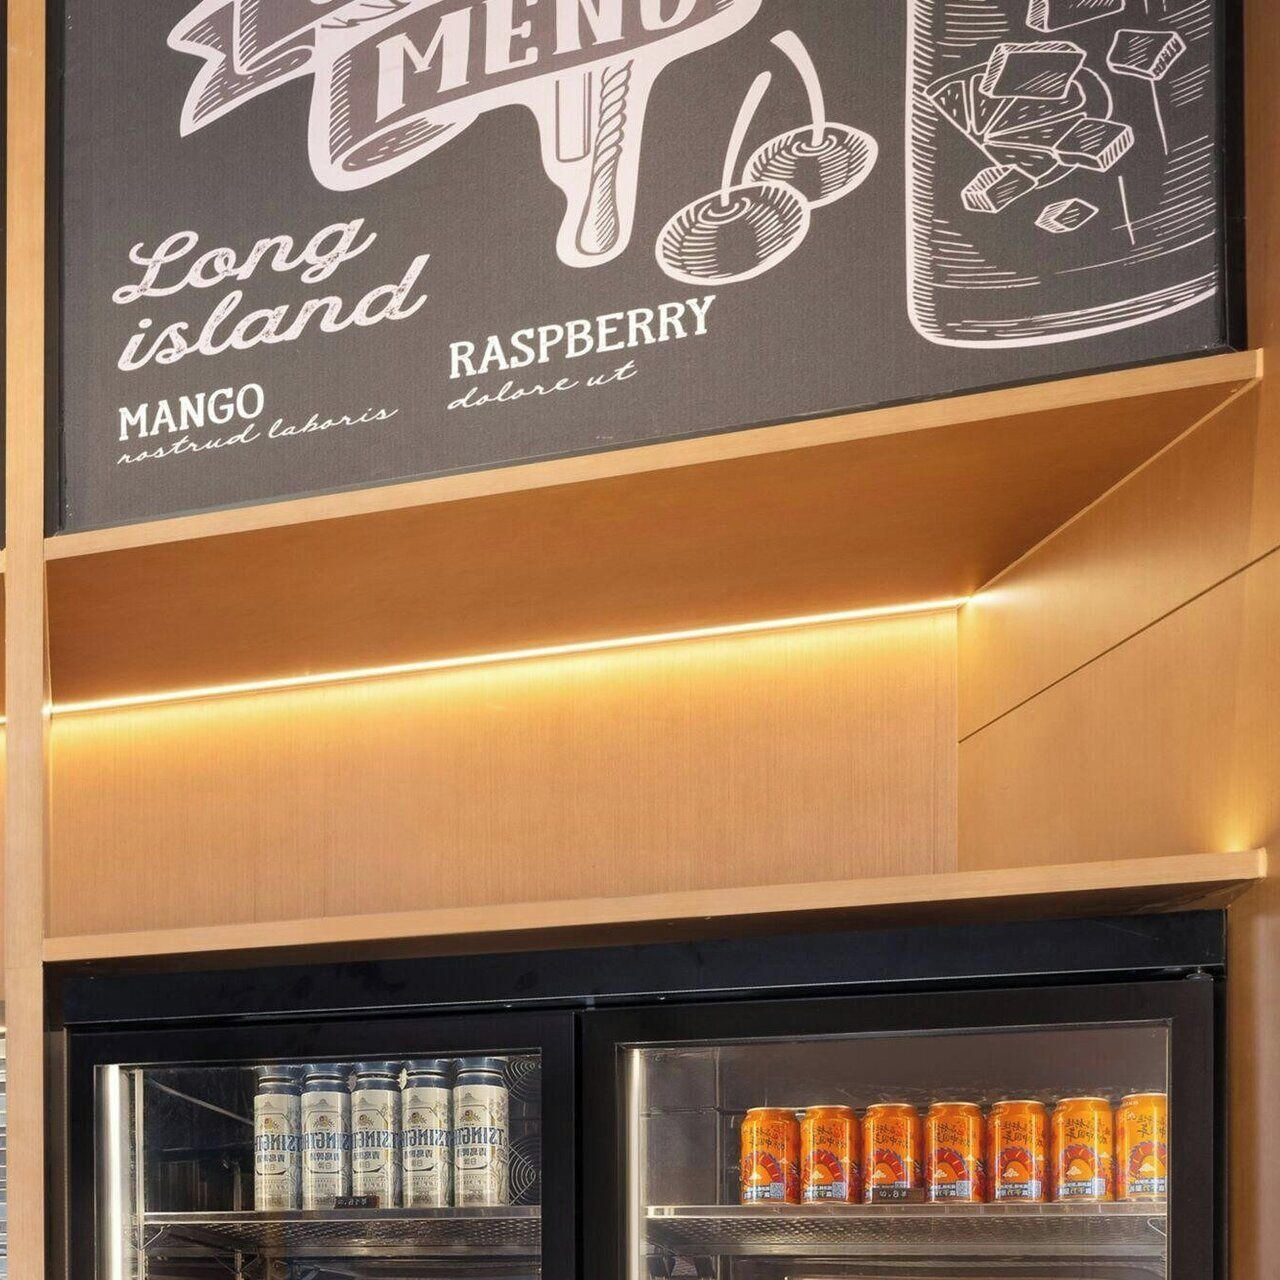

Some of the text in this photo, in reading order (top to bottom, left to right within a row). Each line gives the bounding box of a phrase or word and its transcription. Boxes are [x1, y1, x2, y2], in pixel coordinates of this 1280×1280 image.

[112, 218, 378, 304] Long
[117, 254, 431, 372] island
[448, 295, 717, 379] RASPBERRY
[118, 383, 265, 442] MANGO
[447, 360, 639, 410] dolore ut
[268, 407, 399, 439] laboris
